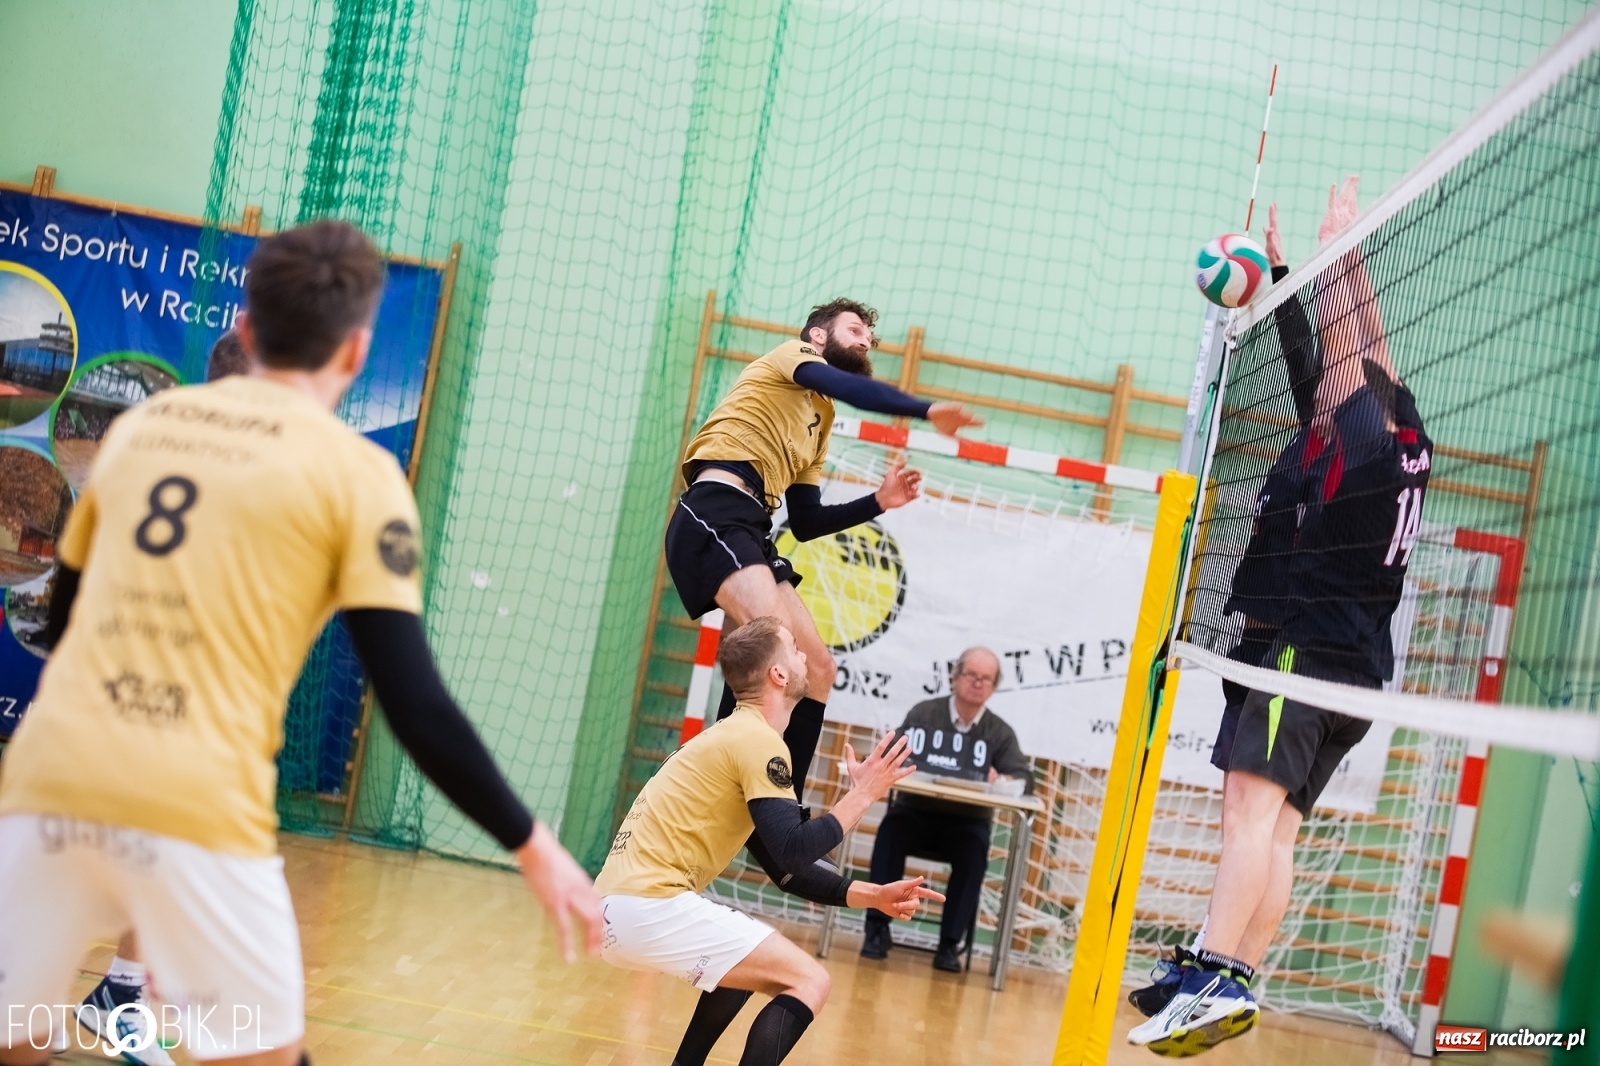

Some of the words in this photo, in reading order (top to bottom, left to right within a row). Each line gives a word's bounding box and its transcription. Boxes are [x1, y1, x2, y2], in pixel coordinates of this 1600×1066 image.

[41, 223, 148, 269] Sportu
[160, 245, 169, 273] i
[121, 288, 149, 312] w
[135, 475, 198, 556] 8
[1383, 487, 1422, 567] 14
[1045, 643, 1085, 678] W
[932, 729, 944, 749] 0
[952, 732, 963, 752] 0
[973, 739, 987, 767] 9
